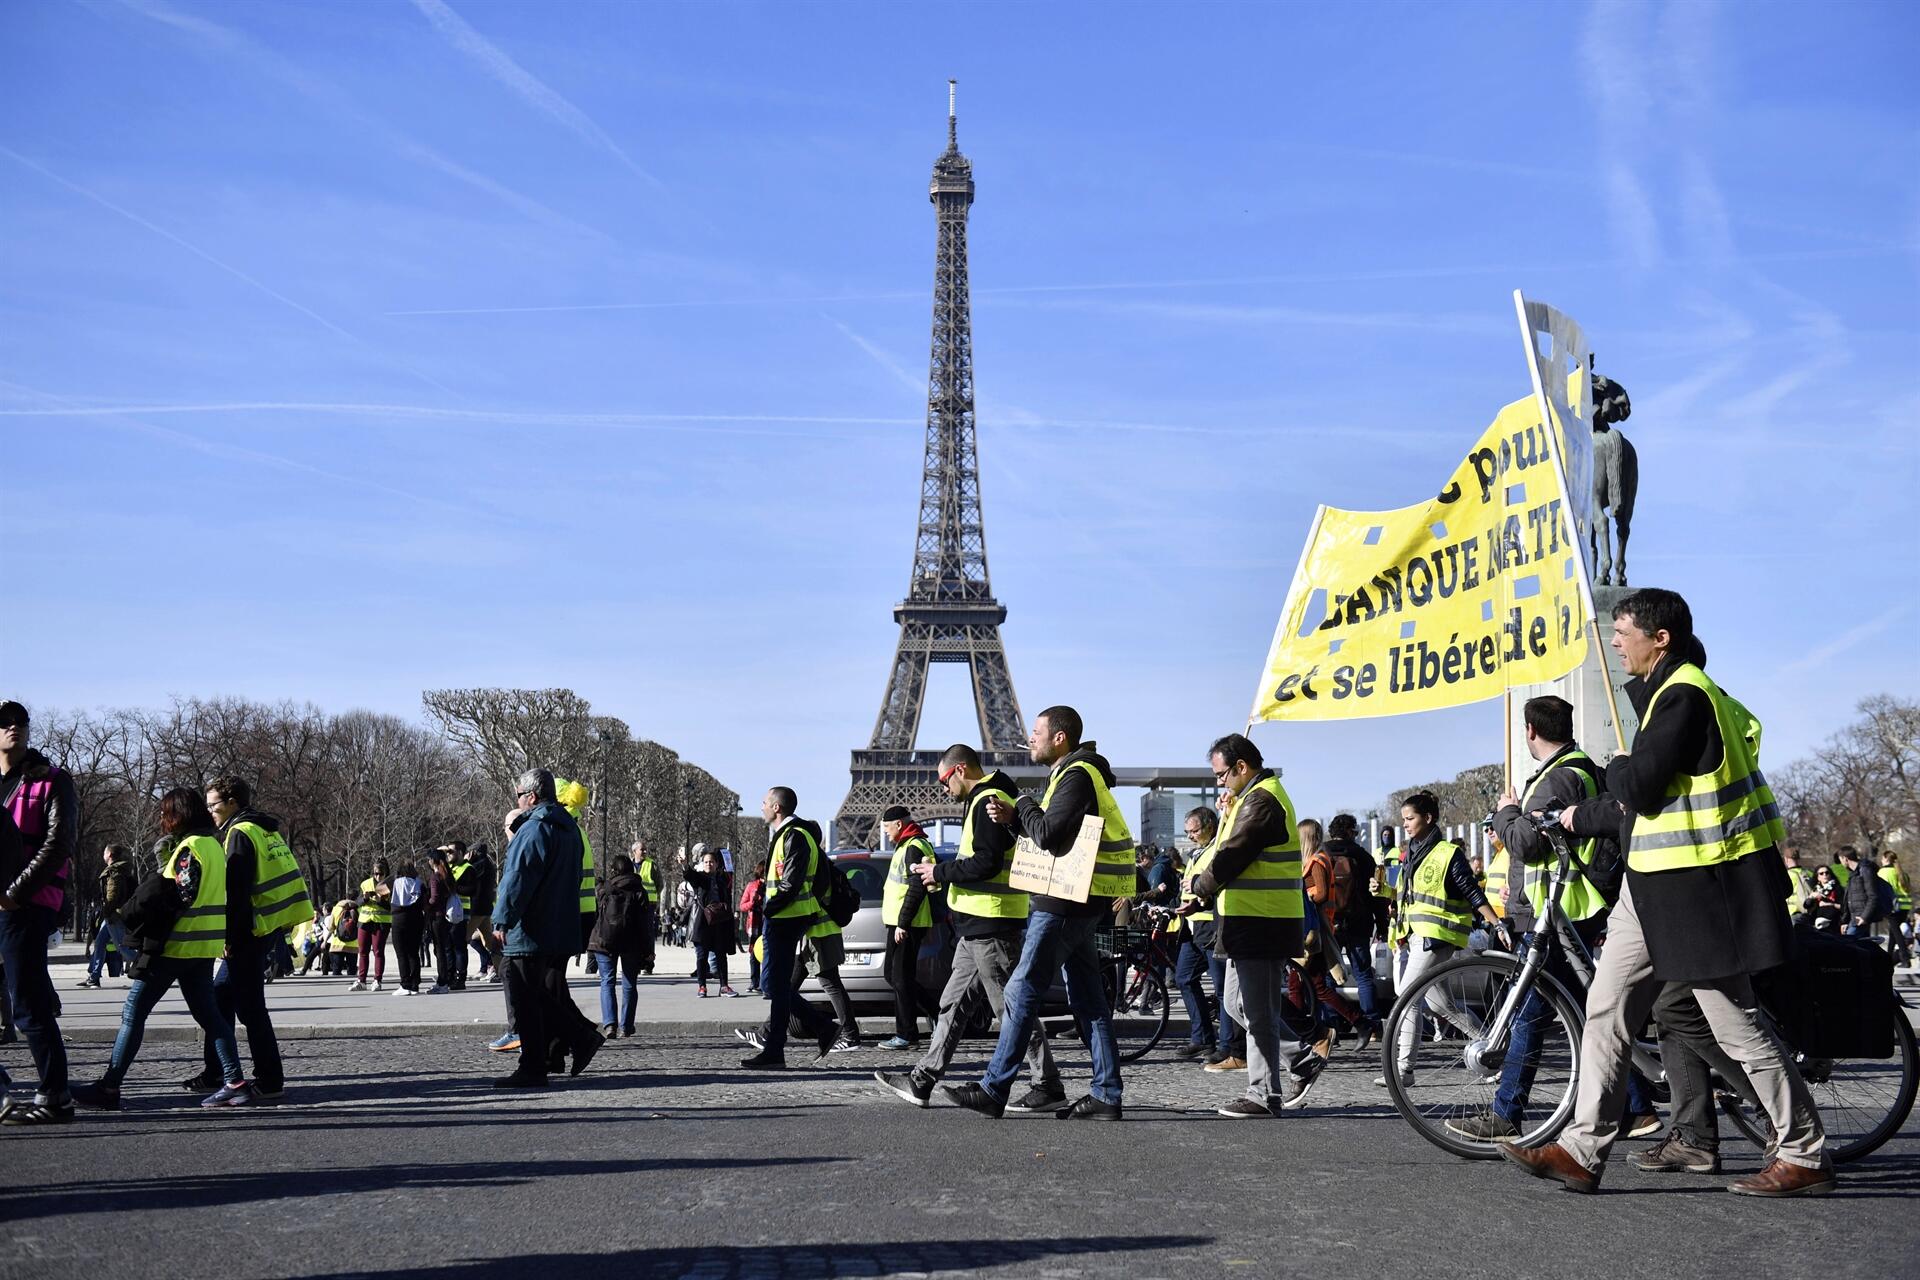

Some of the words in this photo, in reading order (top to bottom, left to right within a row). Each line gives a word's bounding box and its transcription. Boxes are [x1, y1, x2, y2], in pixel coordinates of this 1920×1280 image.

[1274, 664, 1319, 702] et
[1332, 662, 1377, 701] se
[1503, 606, 1548, 663] de
[1080, 824, 1105, 842] TAT
